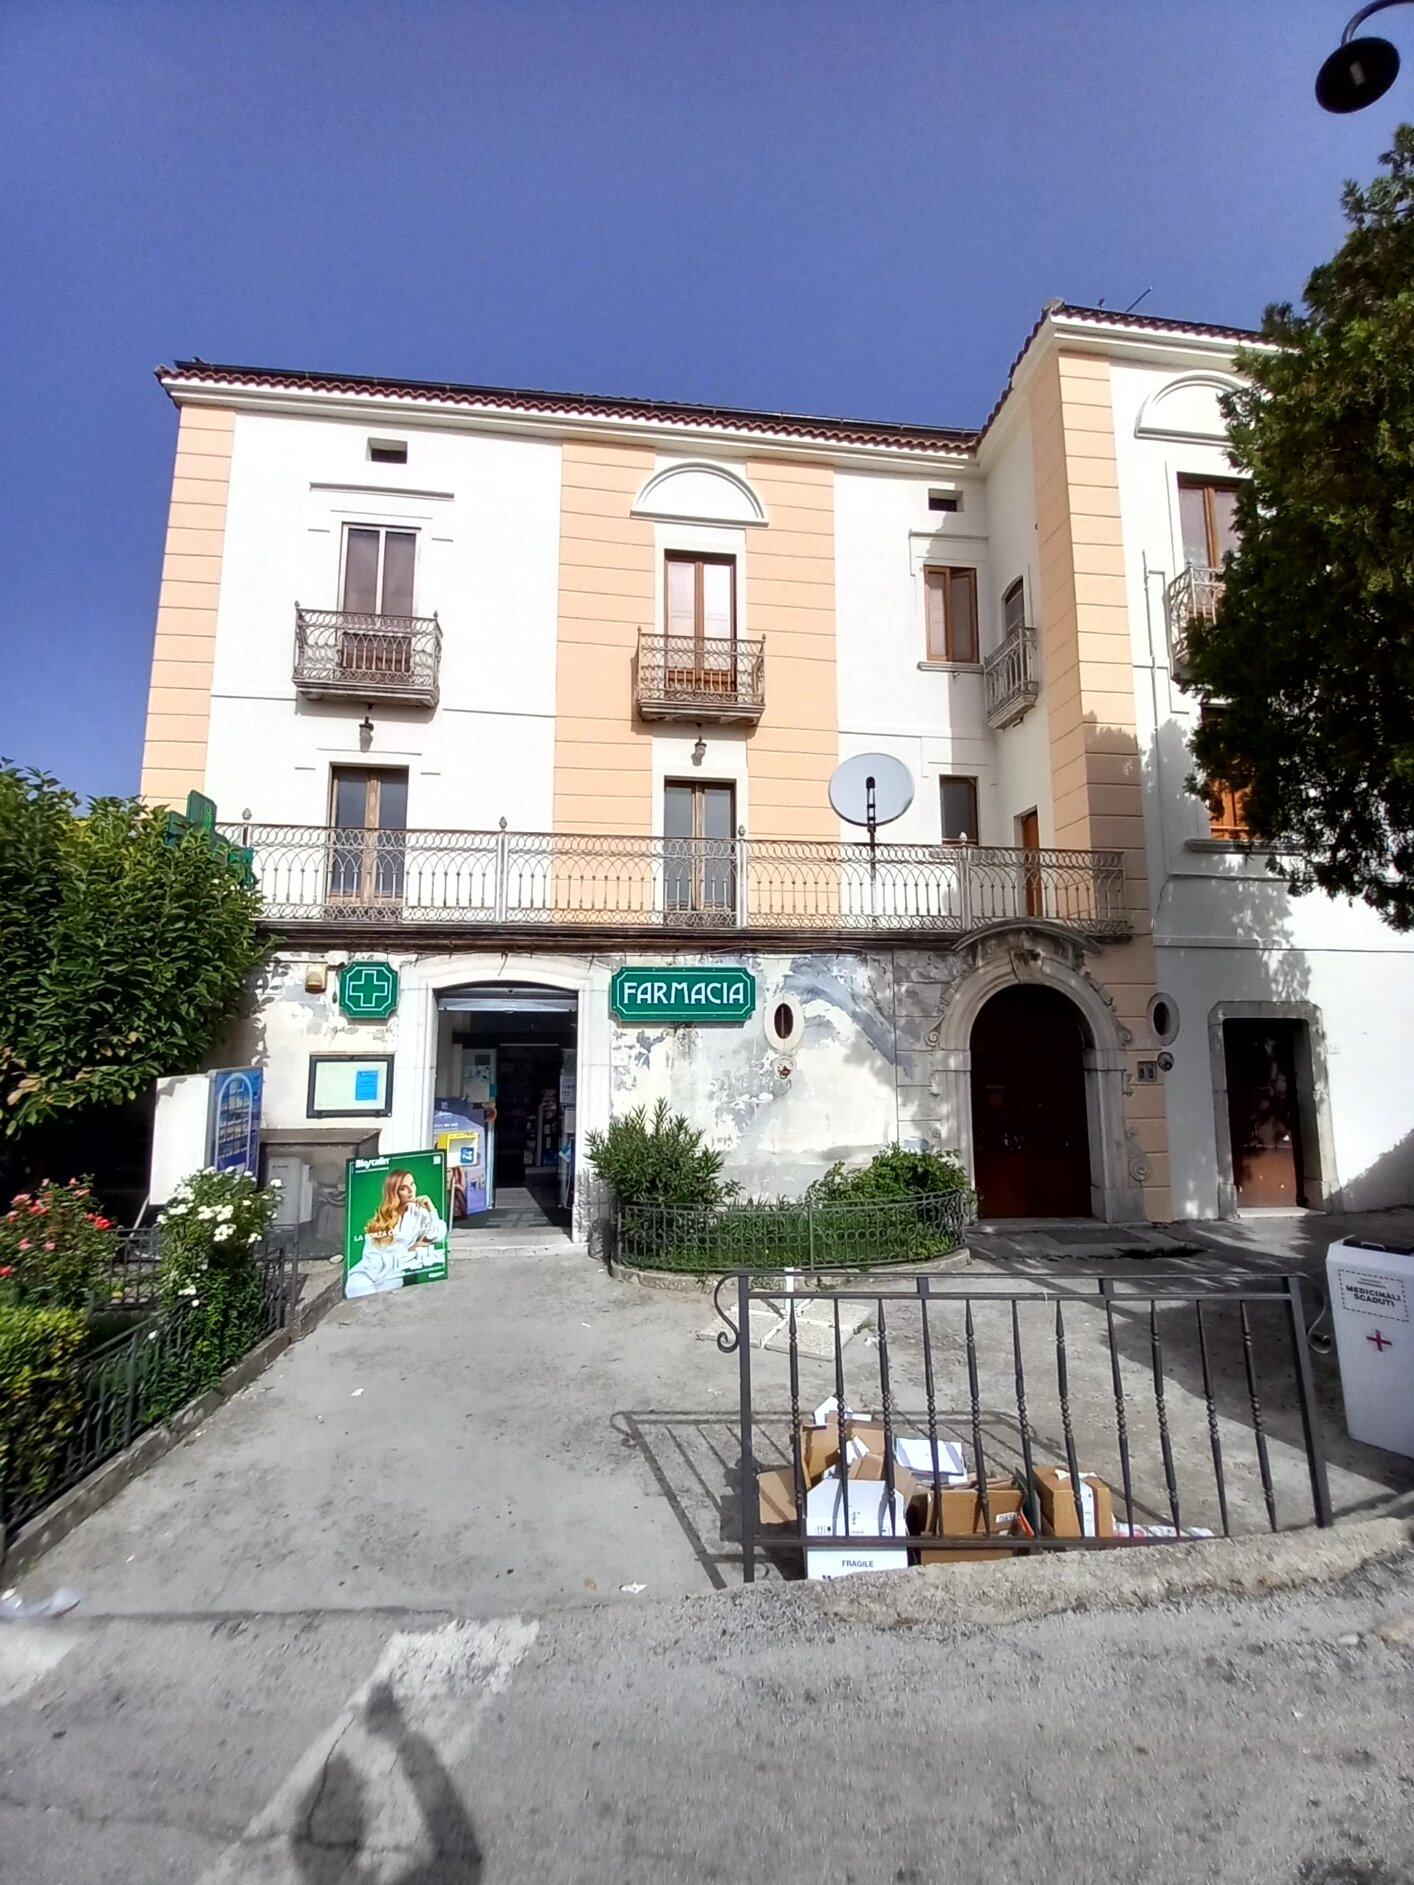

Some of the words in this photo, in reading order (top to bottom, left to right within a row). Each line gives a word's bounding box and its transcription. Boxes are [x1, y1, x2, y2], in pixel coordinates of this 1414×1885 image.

[623, 982, 745, 1004] FARMACIA
[353, 1234, 363, 1242] LA
[1346, 1285, 1401, 1301] MEDICINALI
[1353, 1293, 1395, 1307] SCADUTI
[841, 1560, 874, 1568] FRAGILE
